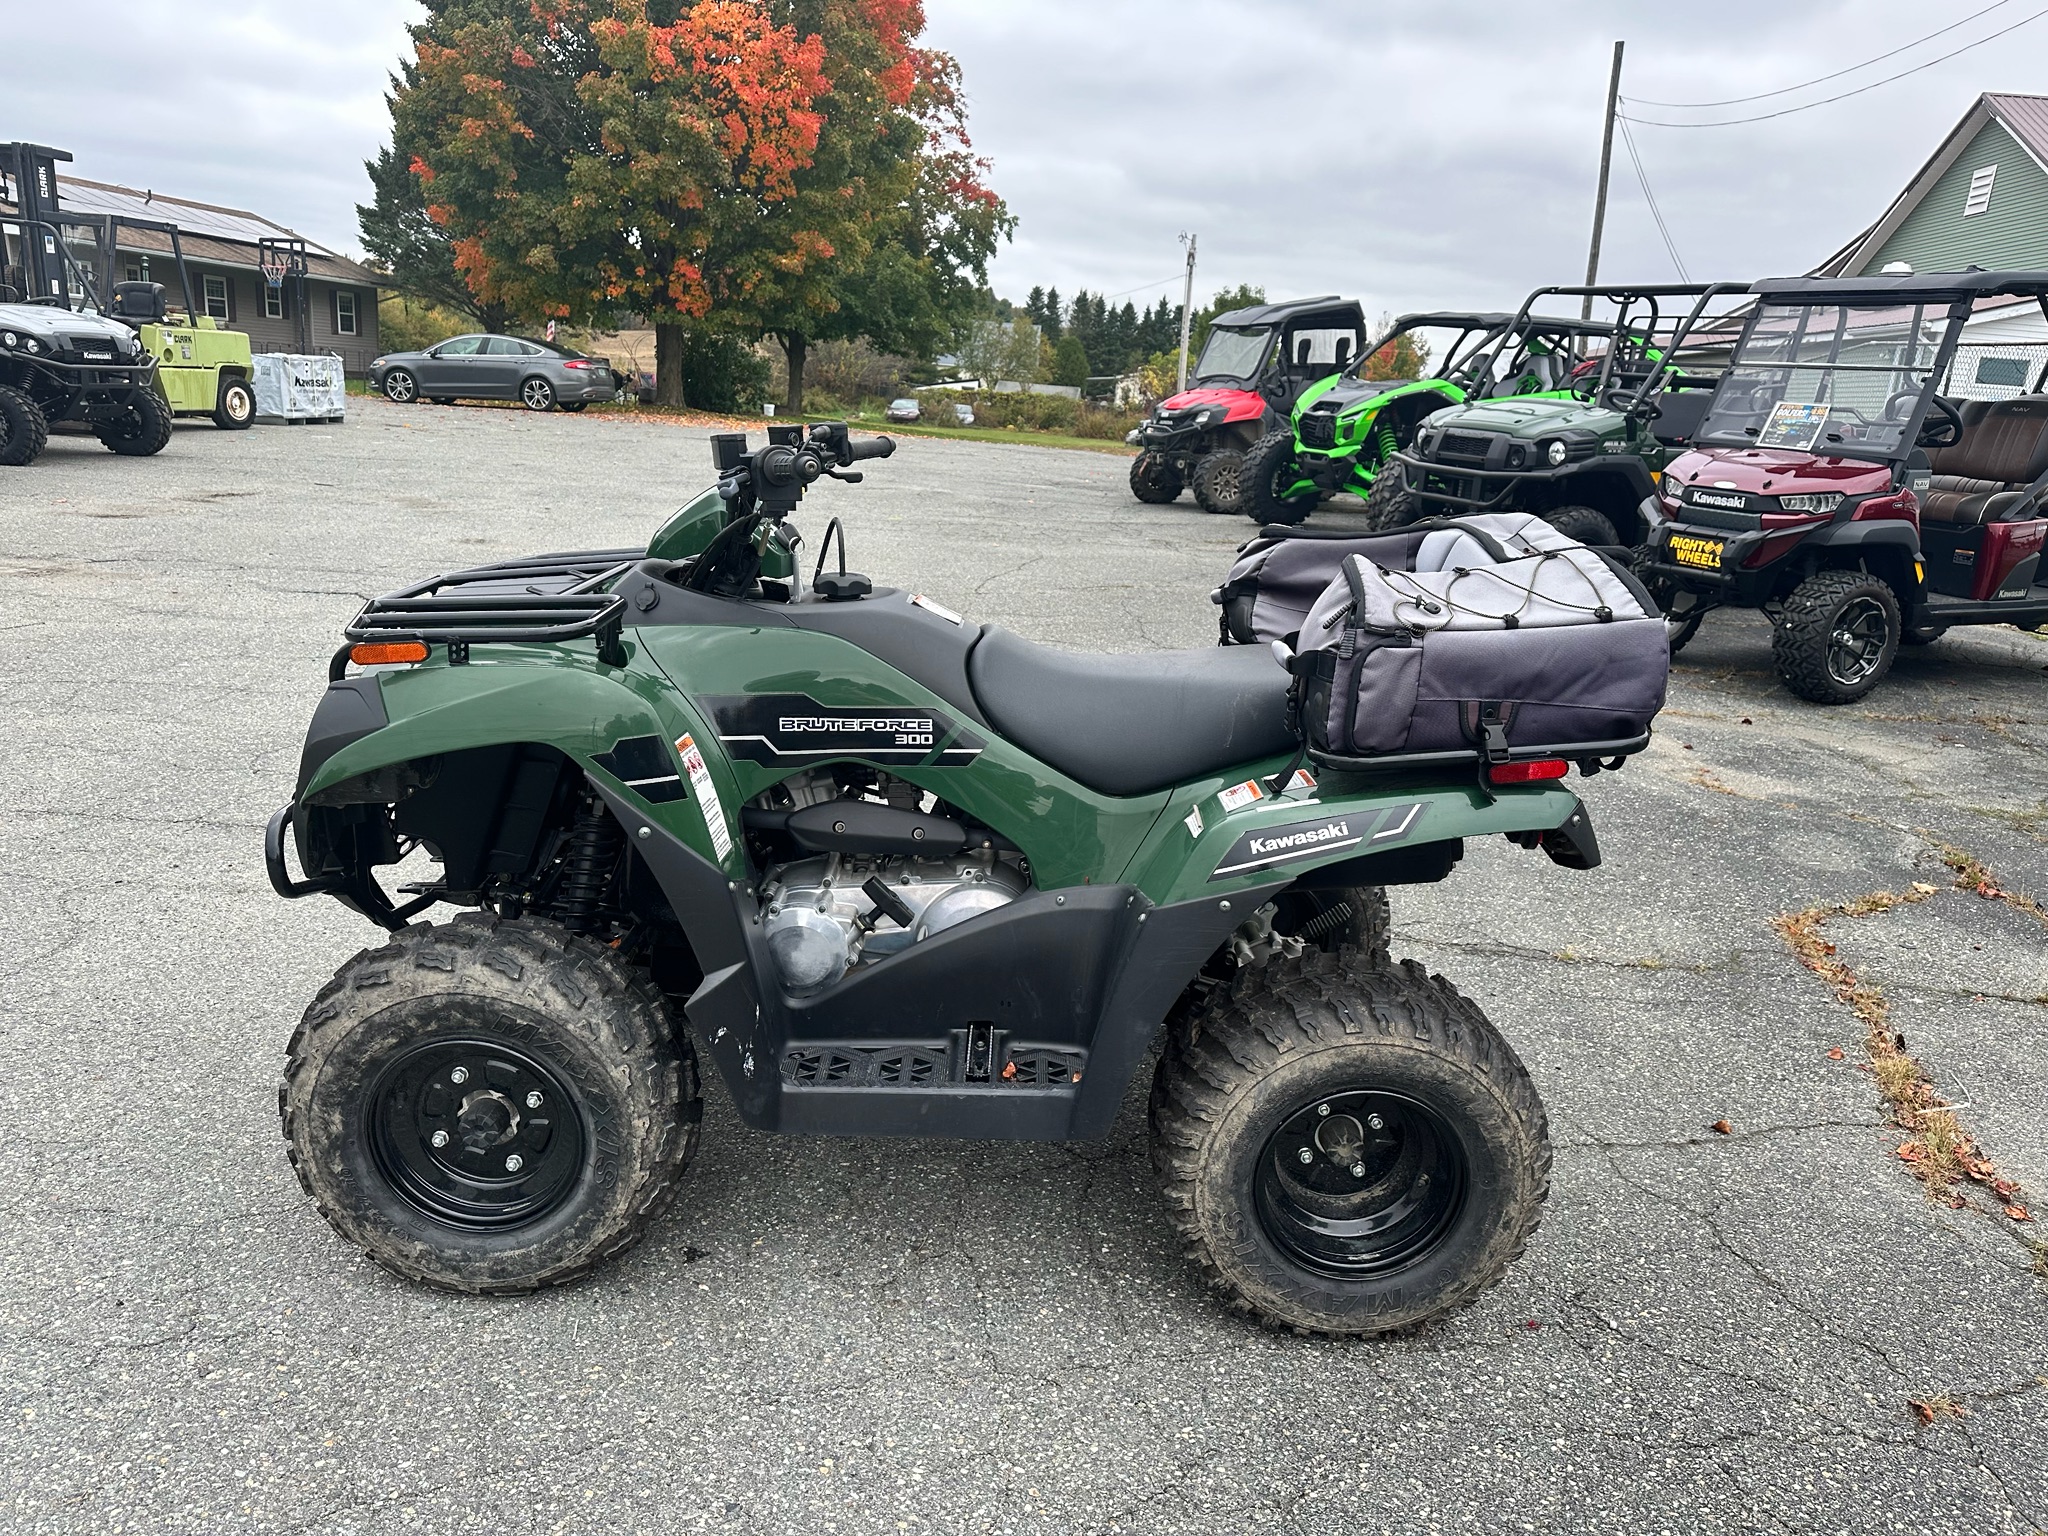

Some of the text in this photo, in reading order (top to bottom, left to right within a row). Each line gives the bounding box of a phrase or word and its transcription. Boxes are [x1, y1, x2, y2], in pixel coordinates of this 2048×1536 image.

[38, 166, 49, 198] CLARK
[174, 335, 193, 344] CLARK
[83, 352, 112, 360] Kawasaki
[294, 376, 332, 387] Kawasaki
[1692, 491, 1746, 508] Kawasaki
[1669, 536, 1707, 552] RIGHT
[1676, 548, 1721, 567] WHEELS
[1998, 588, 2028, 598] Kawasaki
[779, 717, 933, 732] BRUTE FORCE
[894, 734, 933, 745] 300
[1249, 821, 1350, 855] Kawasaki
[491, 1013, 619, 1189] MAXXIS
[1222, 1210, 1403, 1317] MAXXIS
